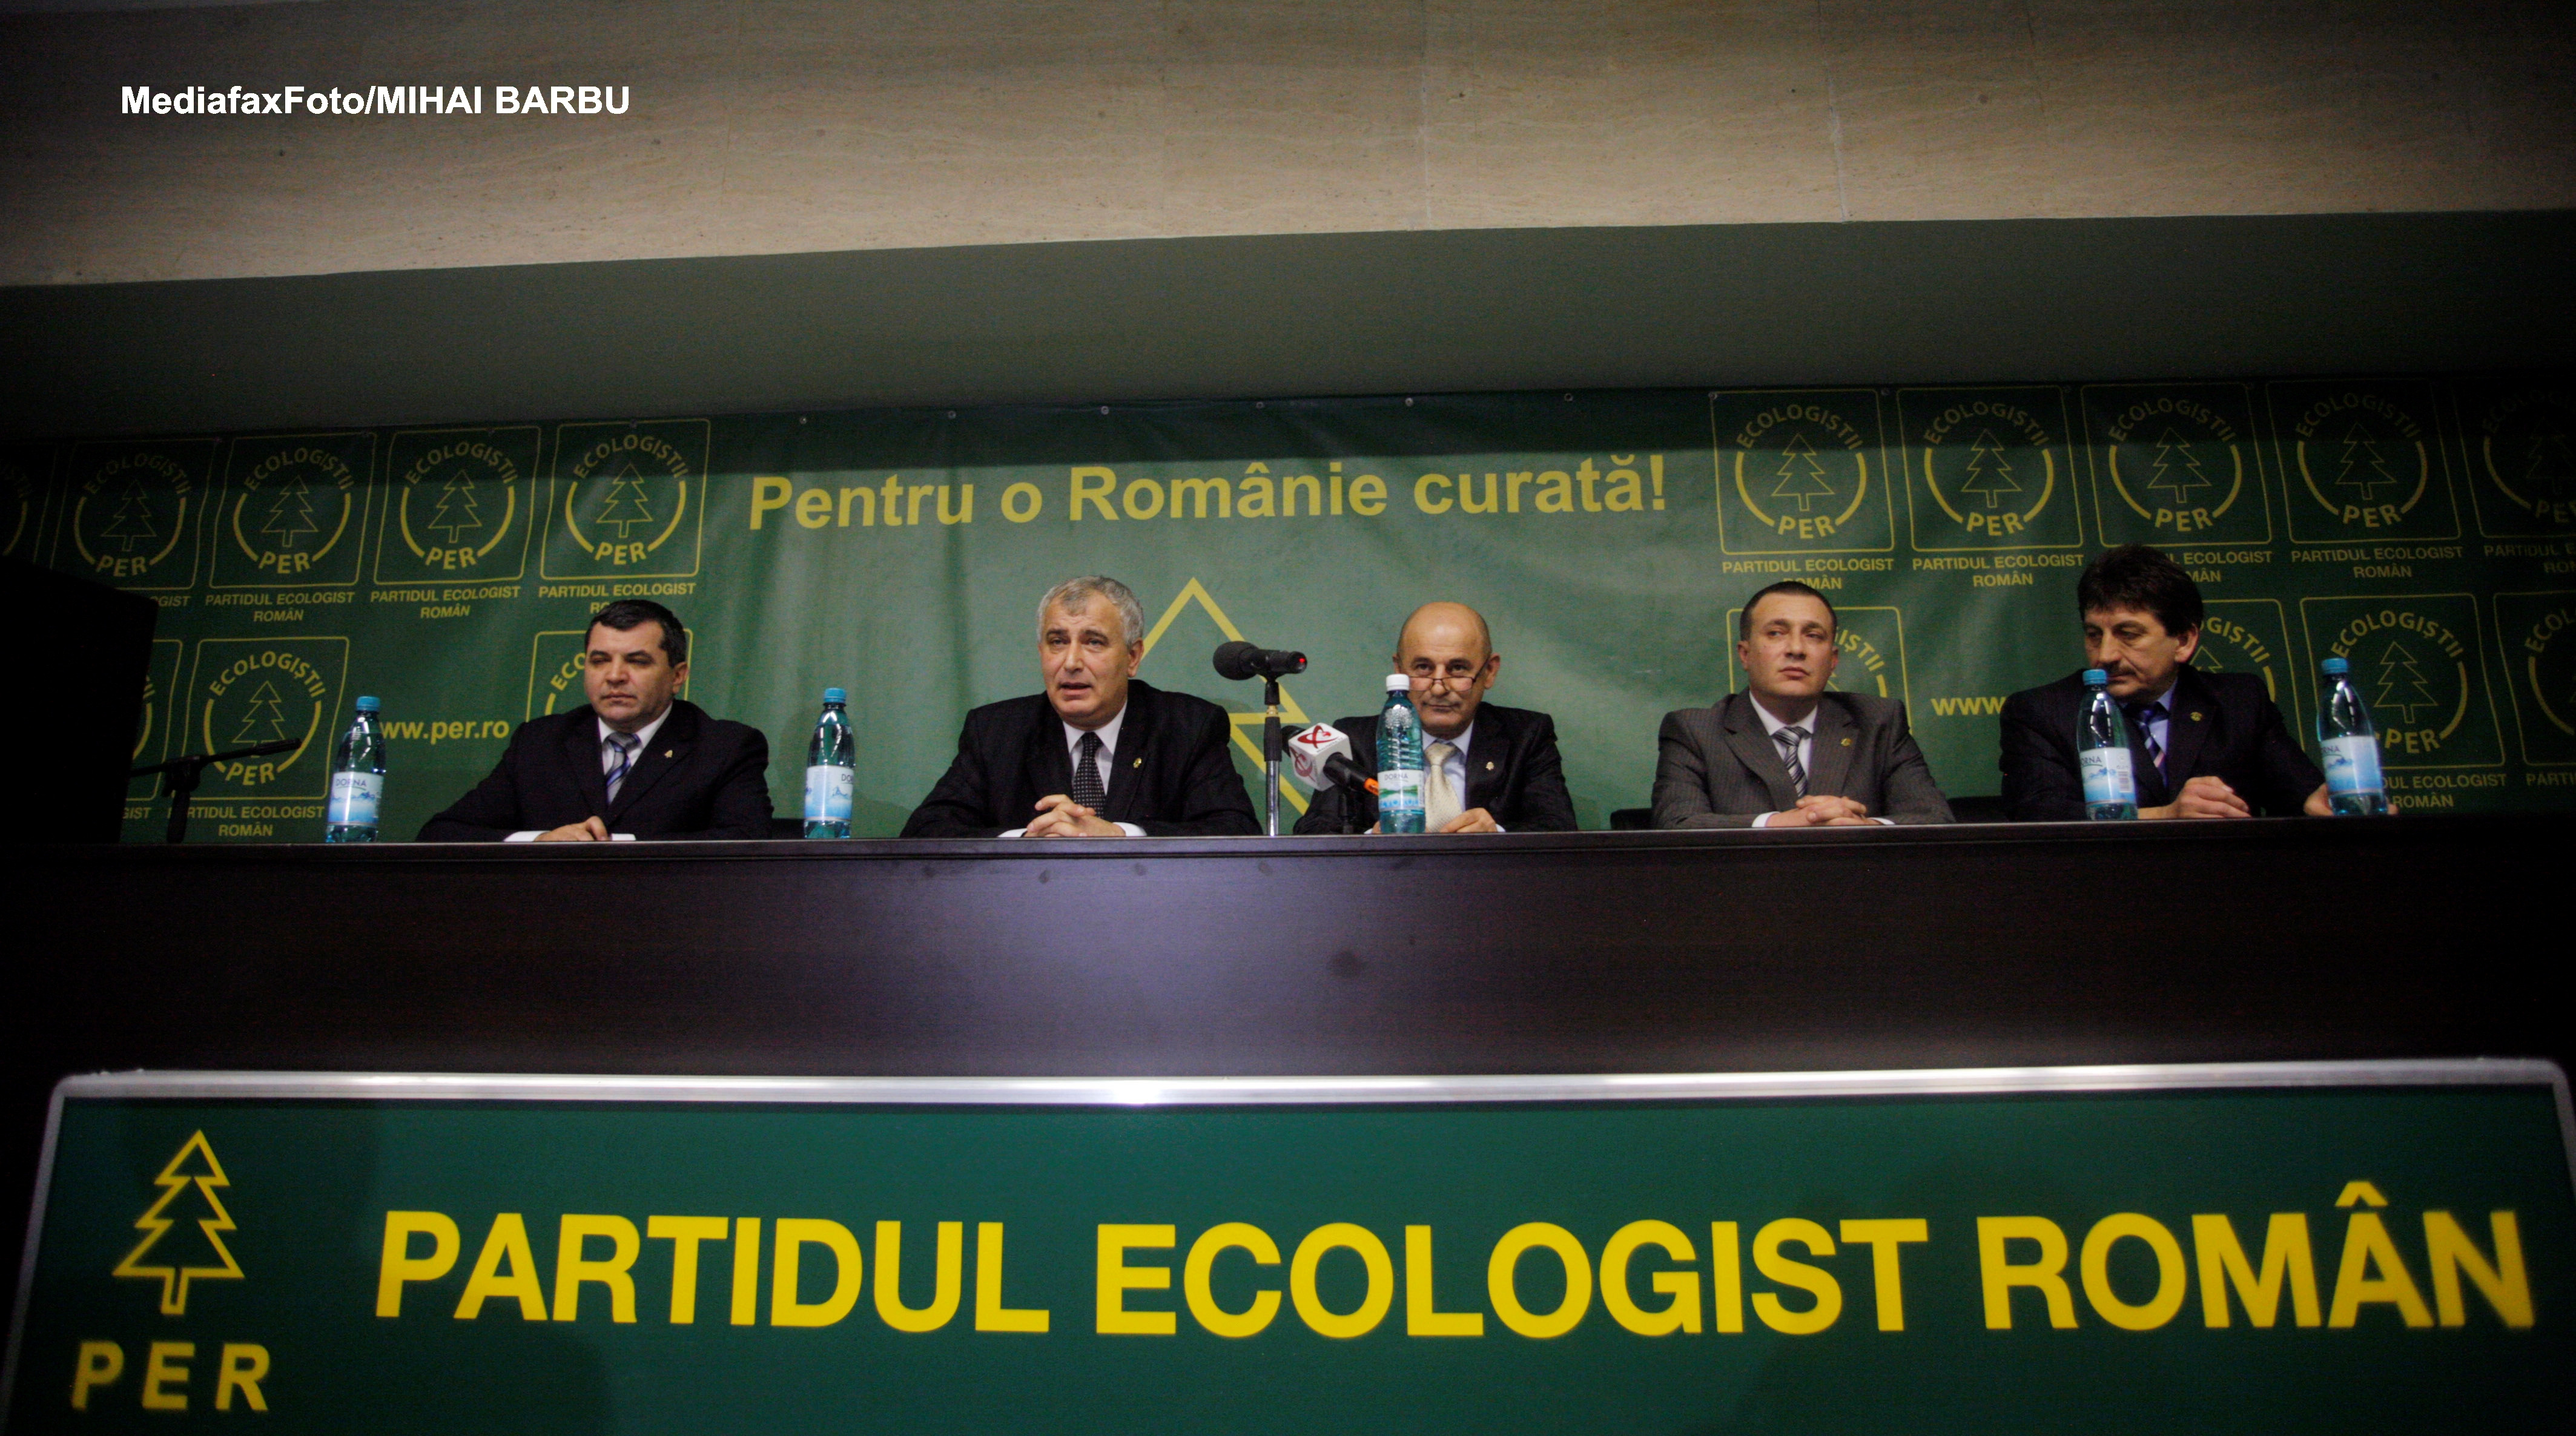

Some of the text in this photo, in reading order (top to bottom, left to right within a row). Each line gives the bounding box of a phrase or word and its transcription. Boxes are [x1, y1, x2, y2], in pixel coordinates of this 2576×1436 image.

[750, 454, 1666, 530] Pentru o Românie curată!
[1966, 512, 2024, 536] PER
[2155, 507, 2214, 531] PER
[2342, 504, 2403, 528] PER
[1777, 515, 1836, 539] PER
[425, 547, 477, 570] PER
[594, 542, 647, 565] PER
[2183, 551, 2273, 564] ECOLOGIST
[2291, 546, 2463, 562] PARTIDUL ECOLOGIST
[95, 555, 147, 577] PER
[259, 550, 311, 574] PER
[1722, 558, 1894, 573] PARTIDUL ECOLOGIST
[1912, 554, 2084, 570] PARTIDUL ECOLOGIST
[2353, 562, 2412, 578] ROMÂN
[1783, 574, 1843, 590] MÂN
[1972, 571, 2034, 587] ROMÂN
[2185, 567, 2222, 582] MÂN
[205, 593, 273, 605] PARTIDUL
[276, 591, 355, 604] ECOLOGIST
[371, 587, 520, 603] PARTIDUL ECOLOGIST
[538, 582, 696, 598] PARTIDUL ECOLOGIST
[254, 607, 303, 622] ROMÂN
[420, 602, 470, 619] ROMÂN
[380, 720, 510, 745] ww.per.ro
[2385, 730, 2442, 754] PER
[225, 762, 275, 785] PER
[2417, 774, 2506, 788] ECOLOGIST
[2525, 771, 2576, 786] PARTI
[2393, 791, 2454, 808] ROMÂN
[167, 806, 325, 819] RTIDUL ECOLOGIST
[219, 822, 273, 836] ROMÂN
[375, 1181, 2534, 1340] PARTIDUL ECOLOGIST ROMÂN
[73, 1342, 270, 1411] PER
